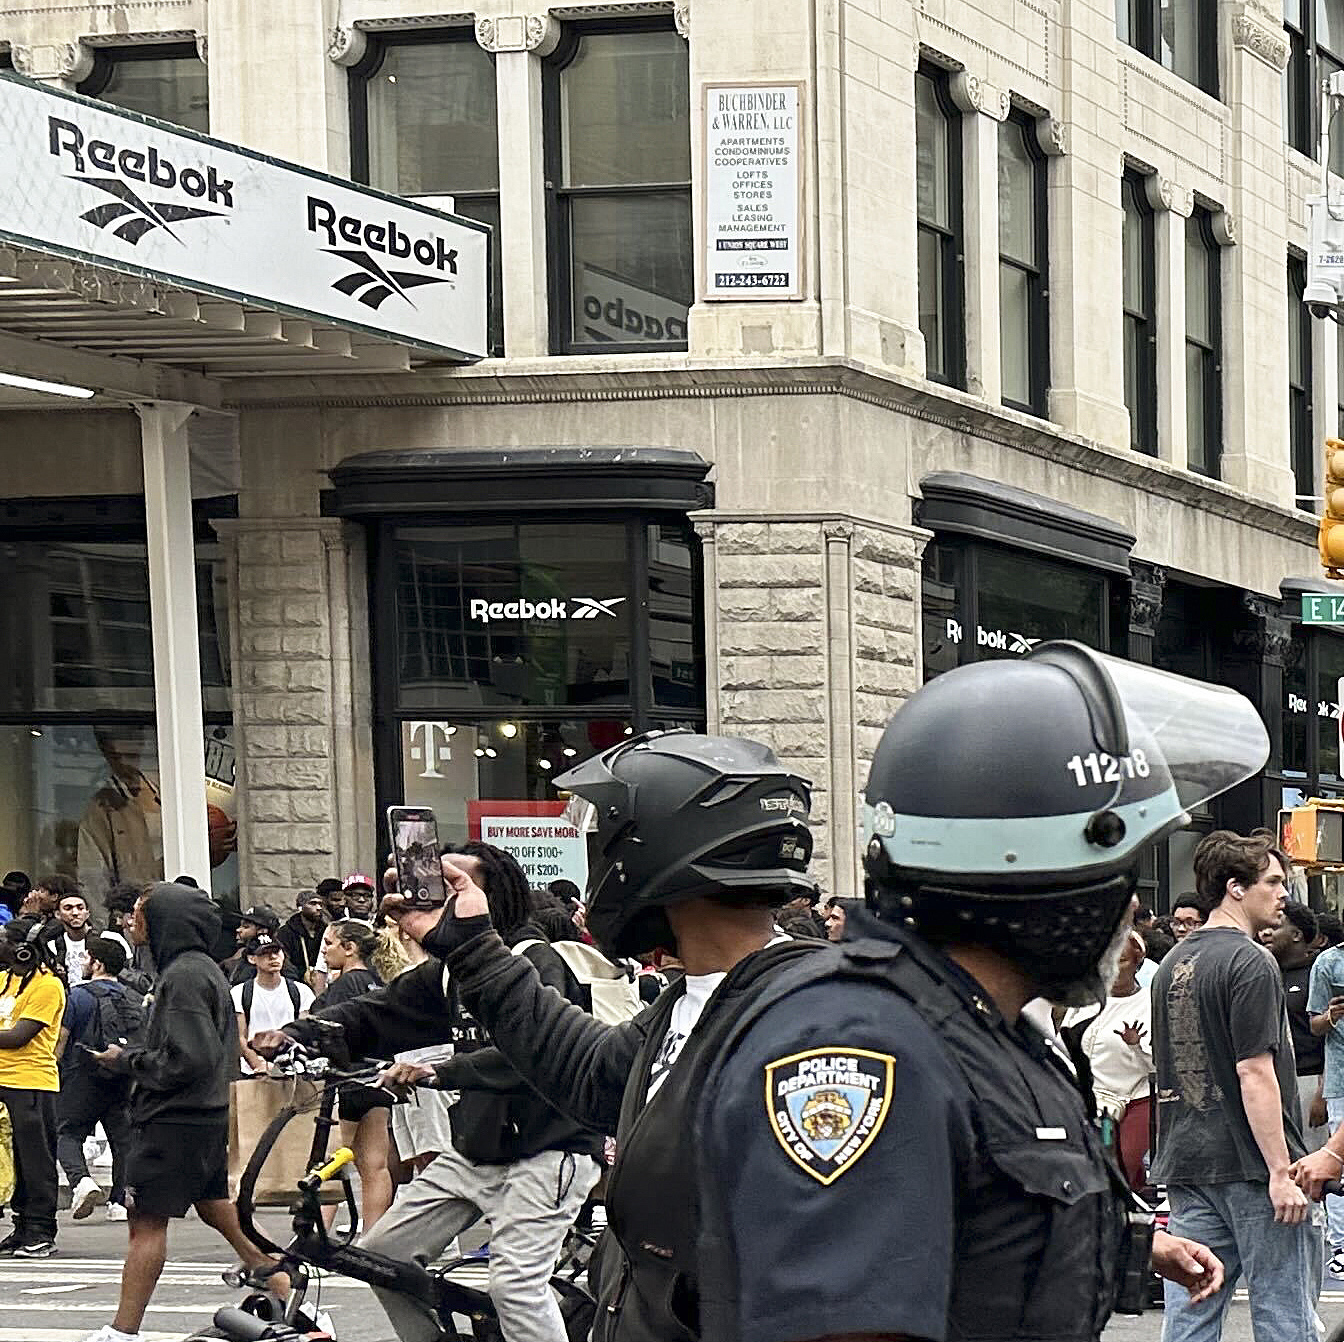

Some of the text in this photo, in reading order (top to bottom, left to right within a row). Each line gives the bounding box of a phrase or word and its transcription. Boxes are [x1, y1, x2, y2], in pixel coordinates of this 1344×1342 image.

[719, 93, 786, 111] BUCHBINDER
[712, 117, 720, 130] &
[774, 117, 793, 130] LLC
[720, 138, 785, 146] APARTMENTS
[714, 147, 790, 156] CONDOMINIUMS
[48, 115, 234, 208] Reebok
[714, 157, 788, 166] COOPERATIVES
[737, 171, 769, 179] LOFTS
[732, 181, 773, 189] OFFICES
[733, 191, 772, 199] STORES
[737, 204, 768, 212] SALES
[732, 214, 773, 222] LEASING
[719, 224, 786, 232] MANAGEMENT
[307, 195, 459, 275] Reebok
[719, 274, 786, 286] 212-243-6722
[470, 598, 566, 623] Reebok
[1311, 598, 1322, 620] E
[1067, 749, 1150, 787] 11218
[487, 827, 579, 839] BUY MORE SAVE MORE
[522, 846, 536, 858] OFF
[538, 846, 563, 858] $100+
[538, 863, 563, 875] $200+
[798, 1057, 859, 1075] POLICE
[778, 1070, 881, 1097] DEPARTMENT
[776, 1111, 799, 1143] CITY
[794, 1143, 814, 1161] OF
[834, 1136, 862, 1165] NEW
[856, 1097, 884, 1135] YORK
